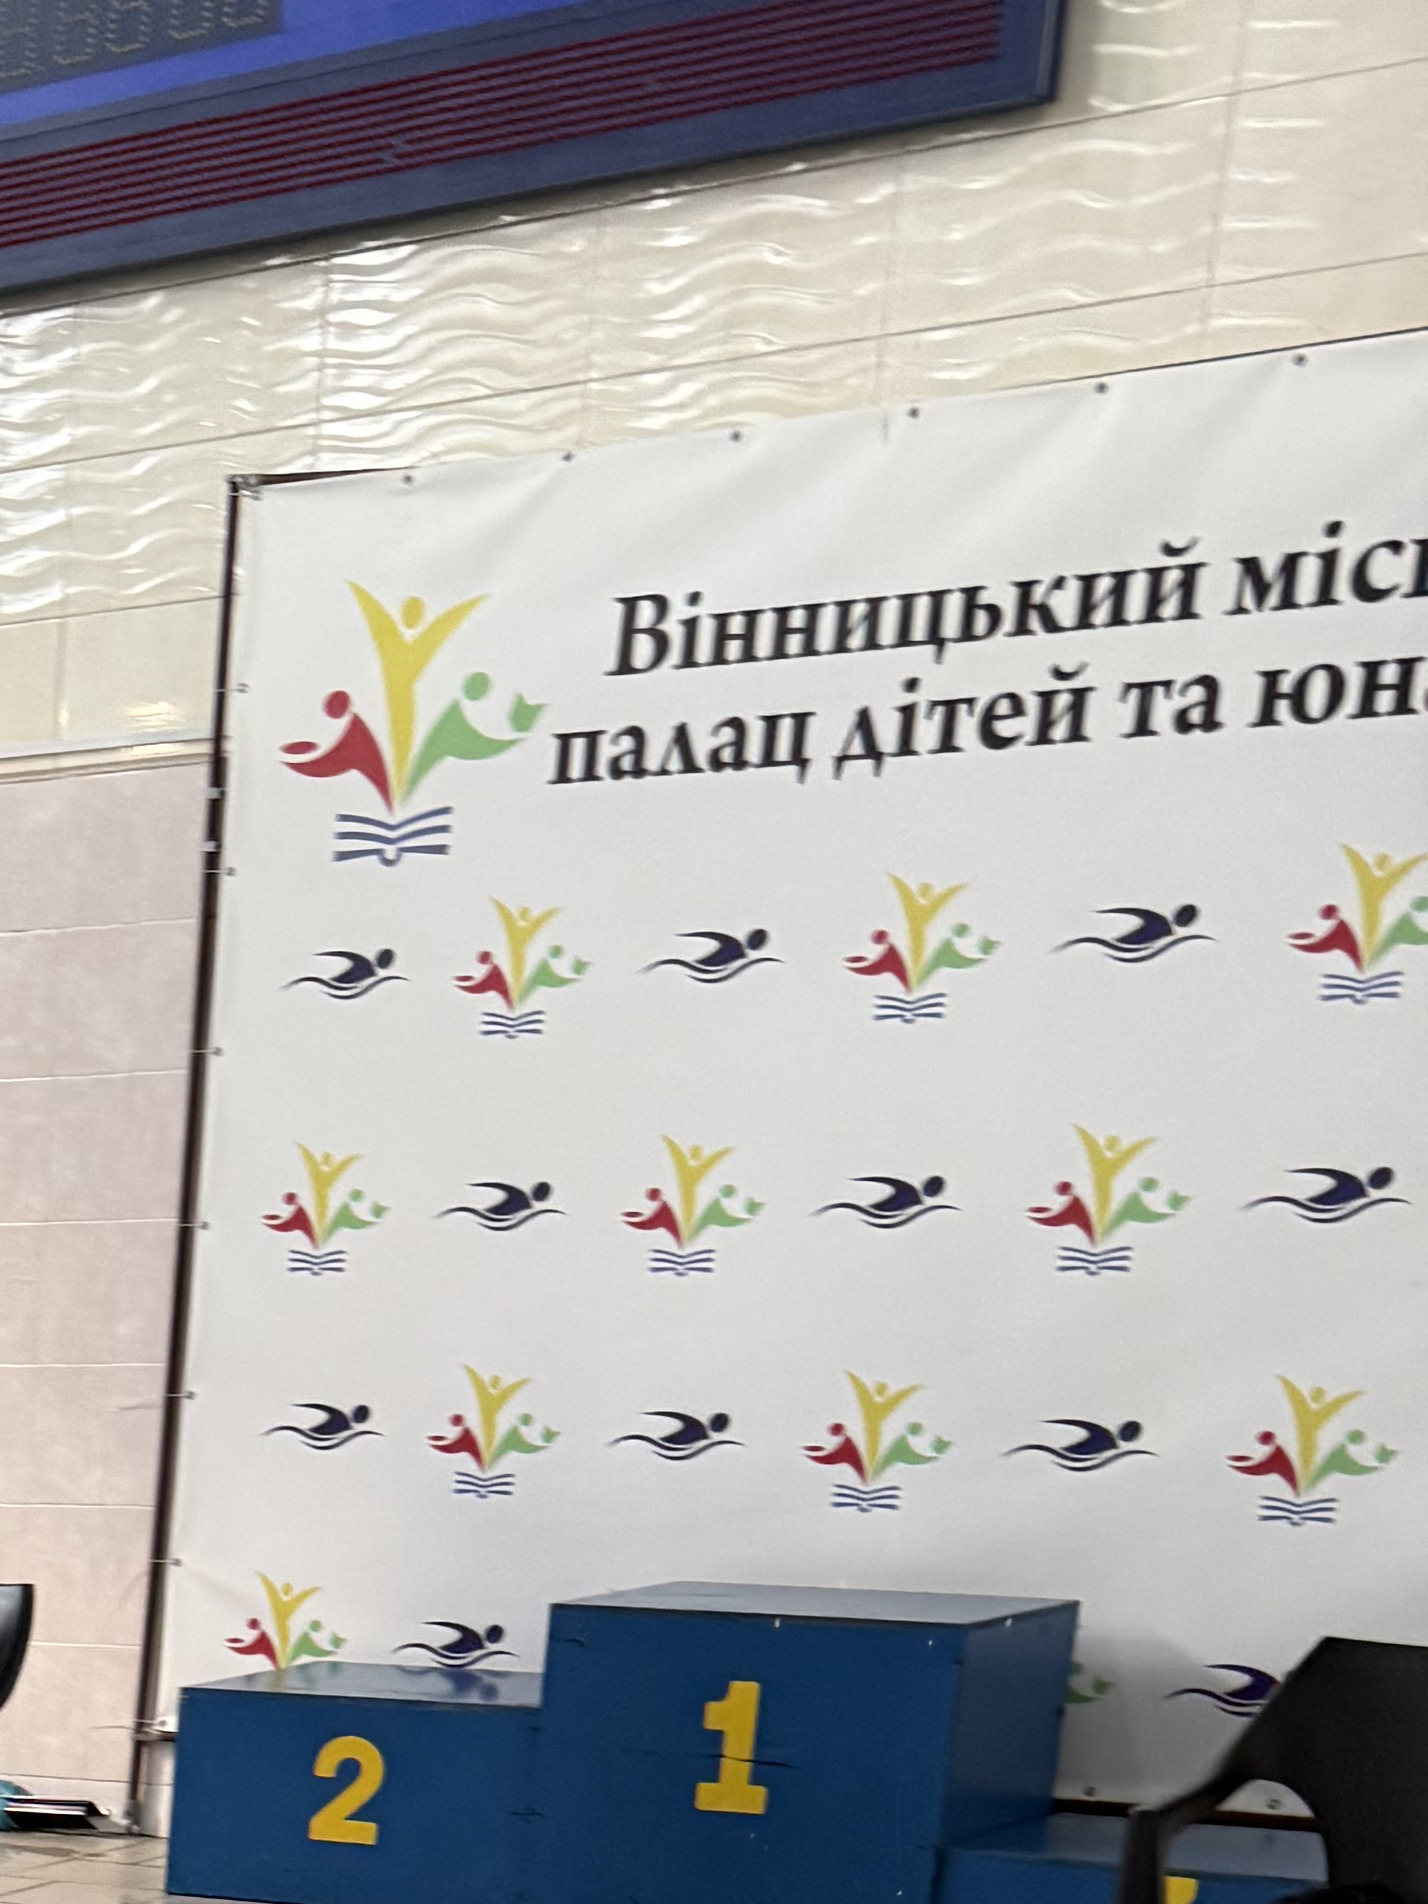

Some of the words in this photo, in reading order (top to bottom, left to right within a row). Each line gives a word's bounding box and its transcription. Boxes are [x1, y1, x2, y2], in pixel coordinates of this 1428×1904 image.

[603, 537, 1208, 676] Вінницький
[545, 710, 817, 786] палац
[832, 664, 1096, 780] дітей
[1115, 673, 1224, 741] та
[1247, 656, 1428, 729] юн
[307, 1735, 387, 1846] 2
[693, 1680, 769, 1816] 1
